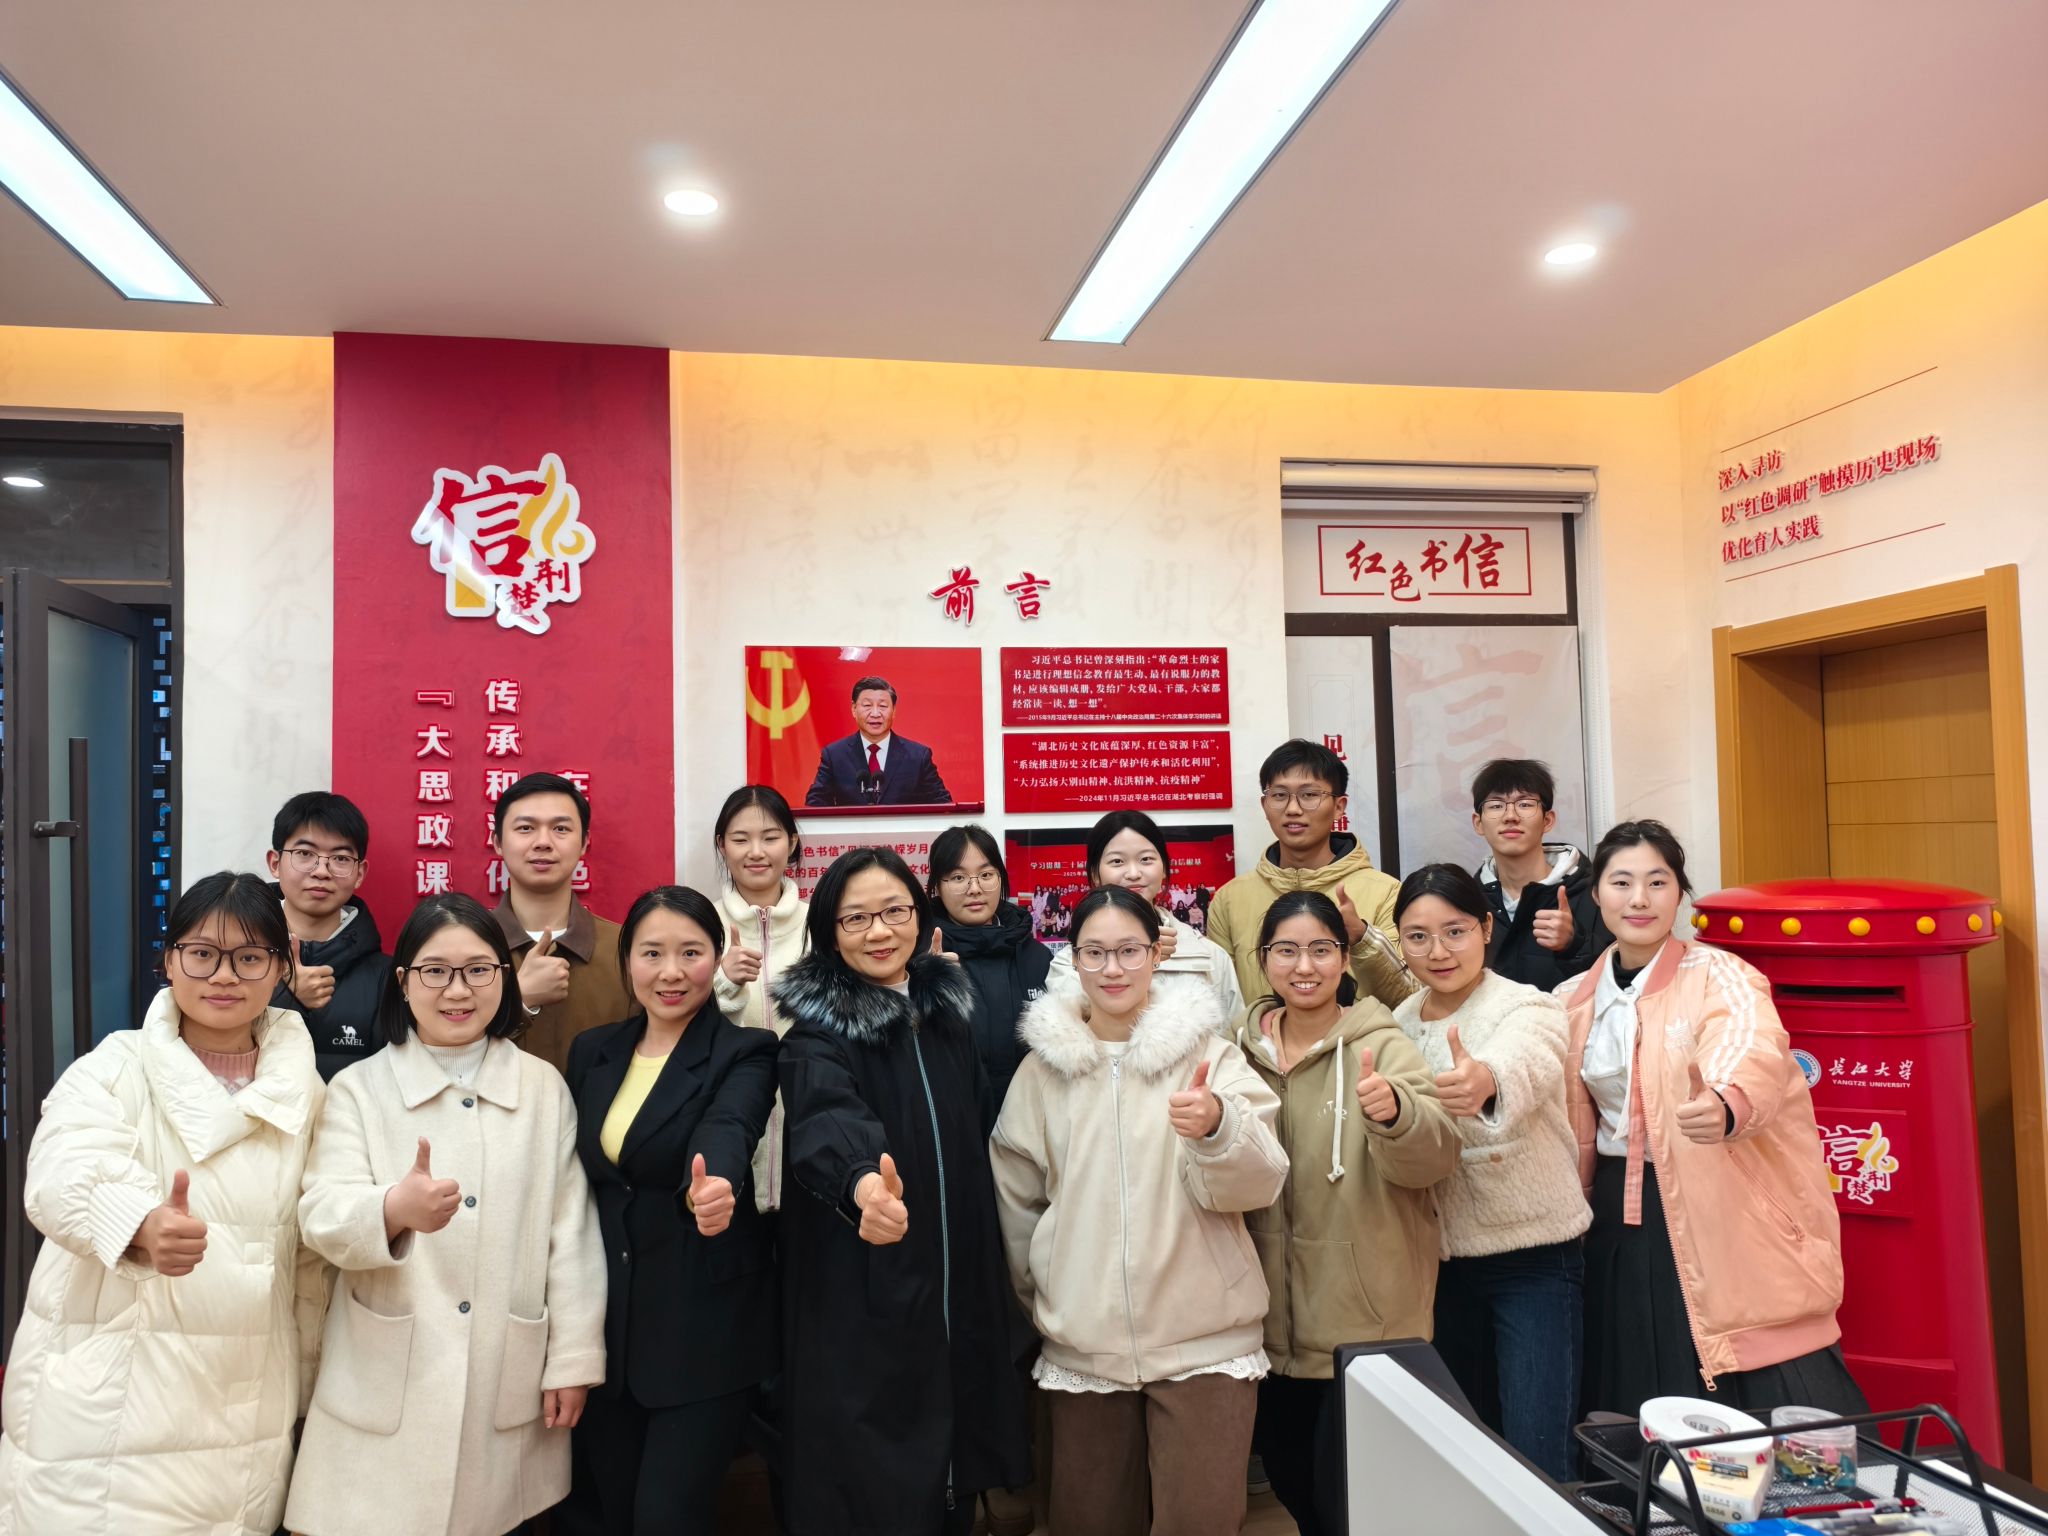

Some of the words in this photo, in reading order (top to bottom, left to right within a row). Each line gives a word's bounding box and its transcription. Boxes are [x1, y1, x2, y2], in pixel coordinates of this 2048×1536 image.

[1718, 450, 1784, 490] 深入寻访
[1721, 436, 1938, 524] 以“红色调研”触摸历史现场
[420, 474, 548, 577] 信
[1722, 515, 1820, 562] 优化育人实践
[1345, 533, 1505, 602] 红色书信
[930, 566, 1051, 625] 前言
[332, 1037, 365, 1047] CAMEL
[1832, 1079, 1867, 1087] YANGTZE
[1869, 1081, 1911, 1089] UNIVERSITY
